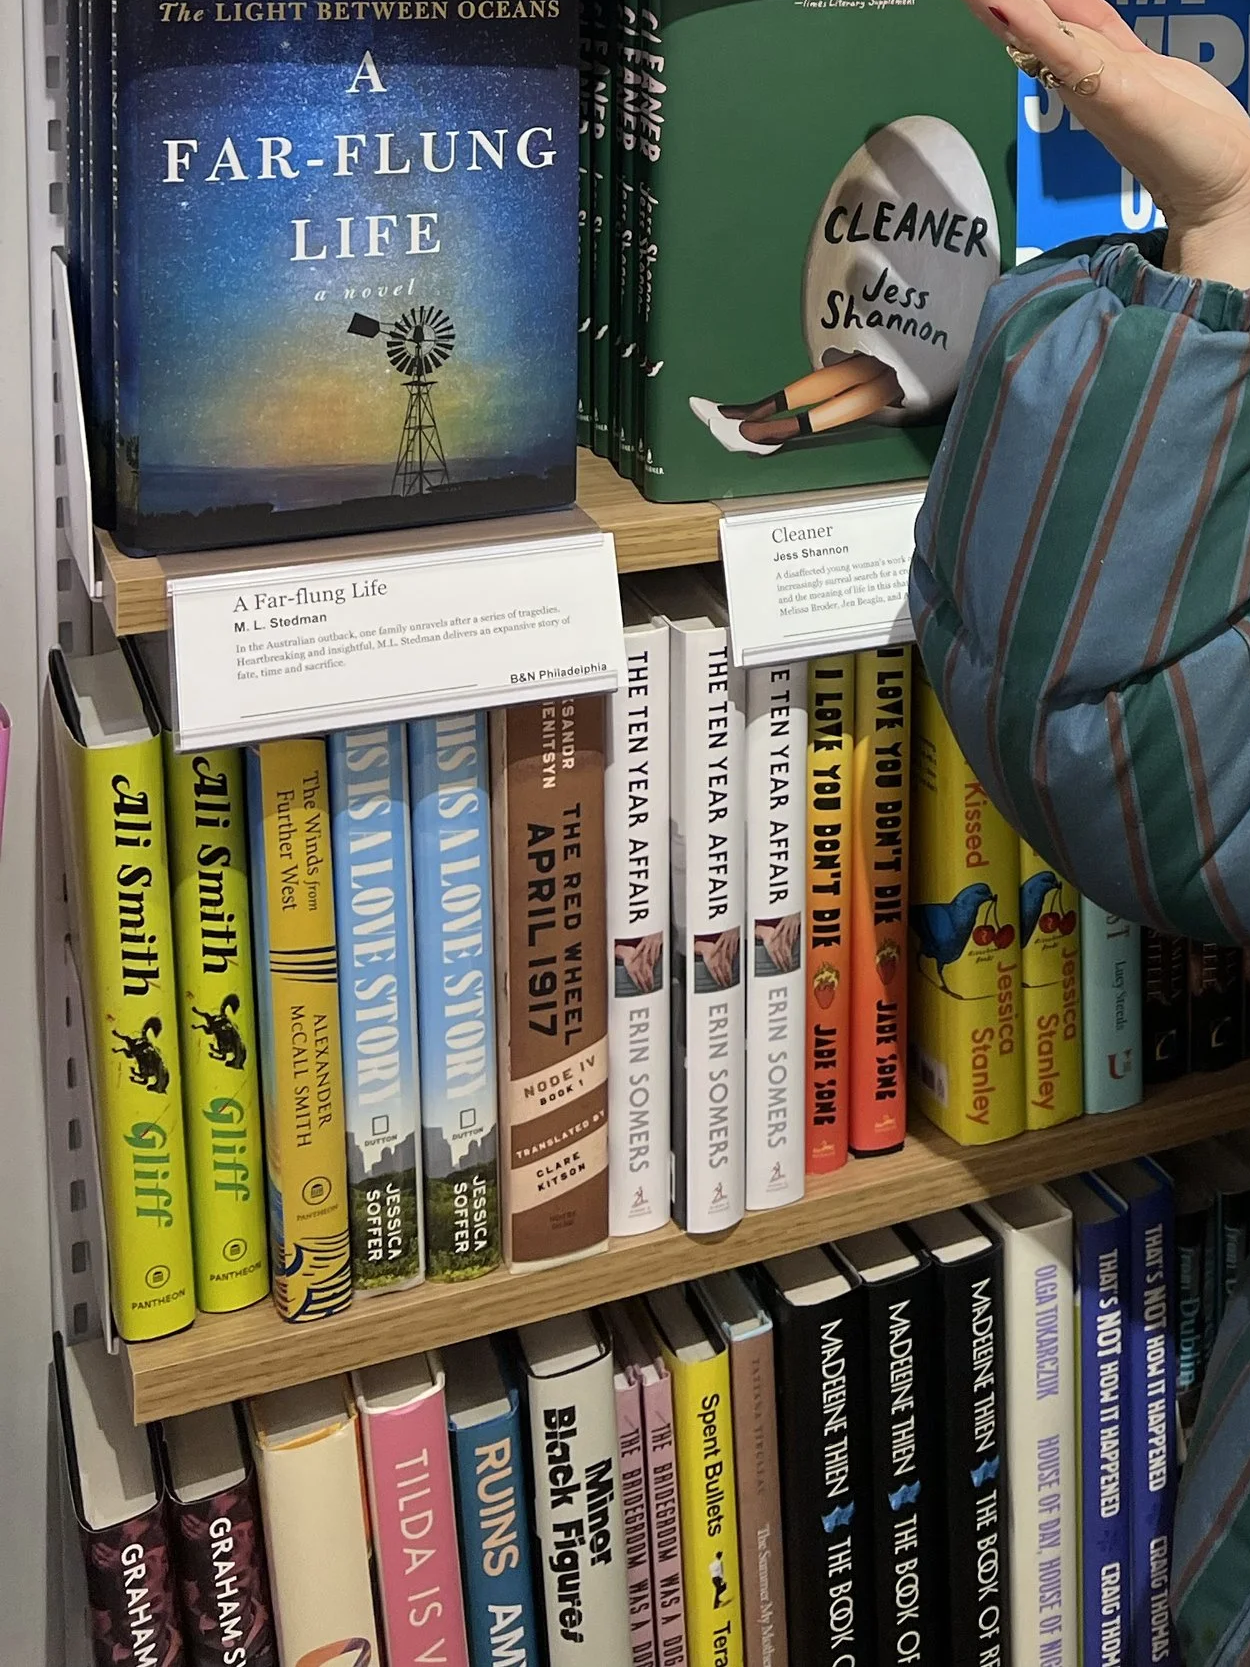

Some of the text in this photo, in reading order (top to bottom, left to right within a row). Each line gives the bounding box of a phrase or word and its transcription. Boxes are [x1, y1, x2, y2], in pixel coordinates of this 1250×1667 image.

[159, 0, 560, 23] The LIGHT BETWEEN OCEANS
[345, 49, 387, 94] A
[162, 127, 557, 185] FAR-FLUNG
[290, 213, 443, 262] LIFE
[824, 201, 990, 259] CLEANER
[861, 267, 930, 311] Jess
[820, 291, 950, 351] Shannon
[772, 525, 833, 543] Cleaner
[232, 580, 388, 613] A Far-flung Life
[510, 662, 608, 684] B&N Philadelphia
[302, 771, 322, 911] The Winds from
[627, 650, 649, 926] THE TEN YEAR AFFAIR
[811, 669, 842, 949] I LOVE YOU DON'T DIE
[112, 774, 160, 997] Ali Smith
[276, 790, 298, 911] Further West
[351, 860, 401, 1106] LOVE STORY
[527, 823, 559, 1037] APRIL 1917
[563, 803, 585, 1047] THE RED WHEEL
[996, 962, 1015, 1056] Jessica
[629, 1006, 649, 1173] ERIN SOMERS
[970, 1028, 995, 1128] Stanley
[123, 1121, 173, 1229] Gliff
[366, 1190, 383, 1262] SOFFER
[385, 1183, 402, 1261] JESSICA
[1035, 1264, 1058, 1401] OLGA TOKARCZUK
[1097, 1248, 1122, 1519] THAT'S NOT HOW IT HAPPENED
[697, 1393, 723, 1538] Spent Bullets
[820, 1319, 849, 1499] MADELEINE THIEN
[396, 1450, 435, 1575] TILDA
[475, 1437, 519, 1577] RUINS
[543, 1405, 584, 1644] Black Figures
[586, 1459, 614, 1567] Minor
[210, 1517, 244, 1640] GRAHAM
